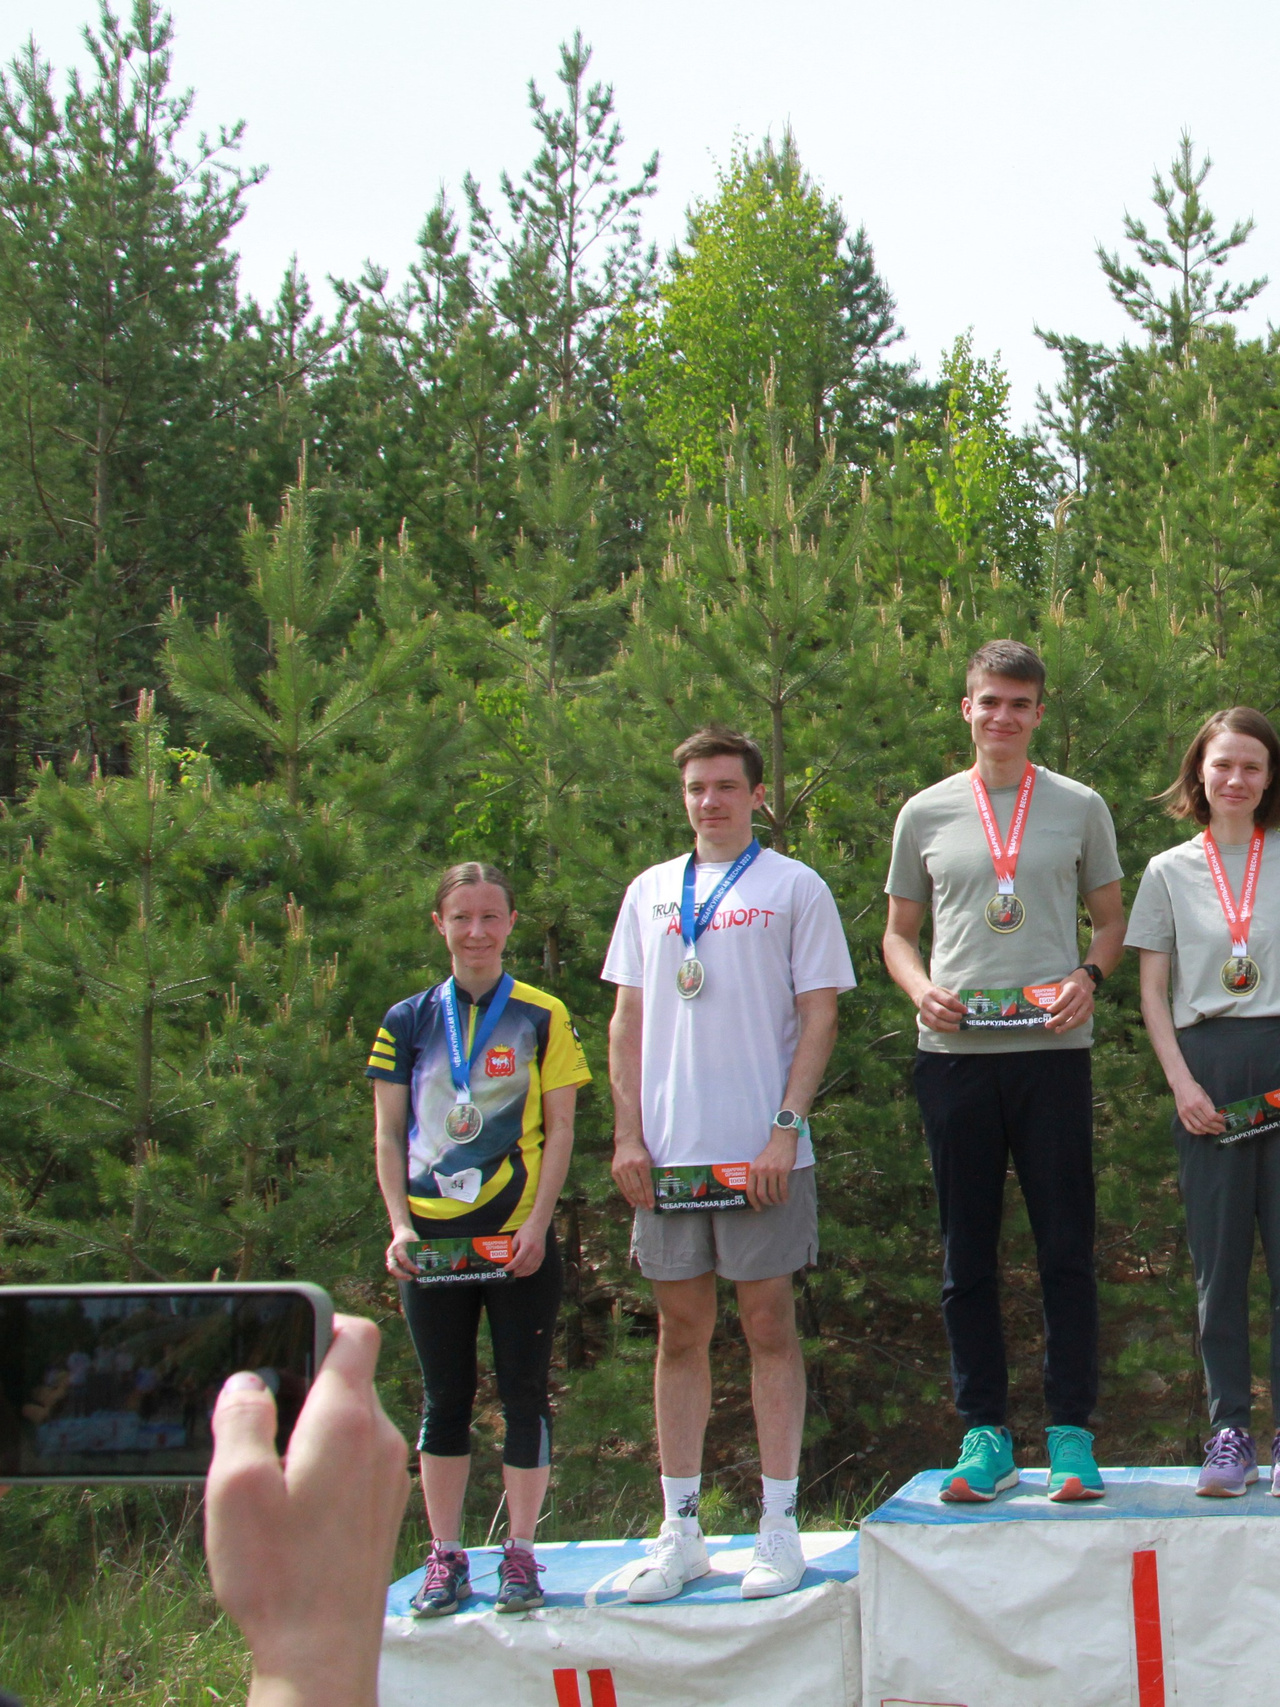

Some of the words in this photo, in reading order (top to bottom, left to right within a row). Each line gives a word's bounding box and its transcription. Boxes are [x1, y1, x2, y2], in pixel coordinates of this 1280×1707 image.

[976, 791, 987, 811] ВЕСНА
[1007, 808, 1024, 857] ЧЕБАРКУЛЬСКАЯ
[1019, 789, 1028, 808] ВЕСНА
[982, 811, 1002, 859] ЧЕБАРКУЛЬСКАЯ
[1210, 854, 1220, 874] ВЕСНА
[698, 879, 731, 926] ЧЕБАРКУЛЬСКАЯ
[727, 864, 743, 881] ВЕСНА
[1240, 872, 1254, 922] ЧЕБАРКУЛЬСКАЯ
[1249, 852, 1258, 871] ВЕСНА
[1216, 874, 1237, 923] ЧЕБАРКУЛЬСКАЯ
[444, 995, 453, 1015] ВЕСНА
[966, 1018, 1028, 1026] ЧЕБАРКУЛЬСКАЯ
[447, 1016, 461, 1067] ЧЕБАРКУЛЬСКАЯ
[1220, 1122, 1279, 1144] ЧЕБАРКУЛЬСКАЯ
[660, 1200, 719, 1210] ЧЕБАРКУЛЬСКАЯ
[416, 1272, 480, 1283] ЧЕБАРКУЛЬСКАЯ
[481, 1271, 507, 1279] ВЕСНА
